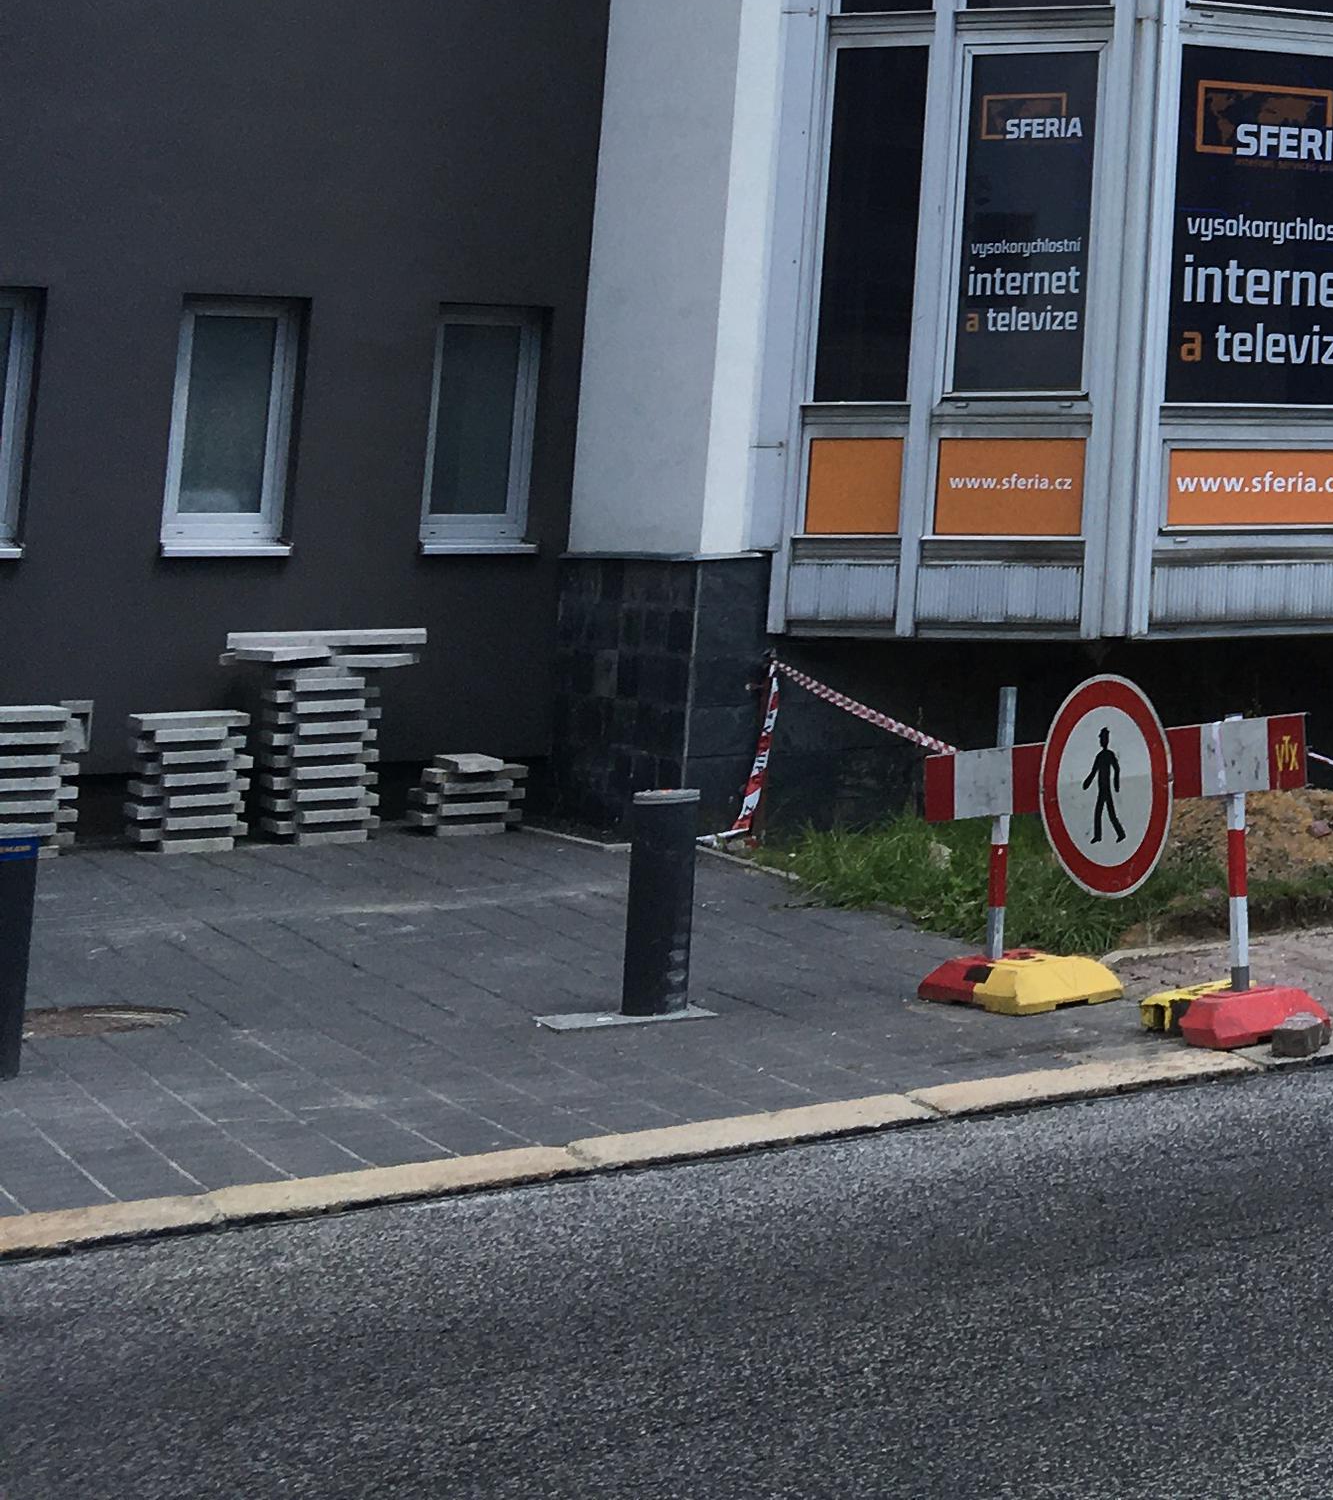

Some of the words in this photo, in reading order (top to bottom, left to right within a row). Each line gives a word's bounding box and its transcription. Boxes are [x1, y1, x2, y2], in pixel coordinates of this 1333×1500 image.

[1006, 117, 1083, 139] SFERIA
[971, 236, 1082, 257] vysokorychlostní
[967, 265, 1081, 297] internet
[966, 311, 979, 332] a
[987, 306, 1078, 333] televize
[1180, 330, 1202, 363] a
[948, 471, 1073, 491] www.sferia.cz
